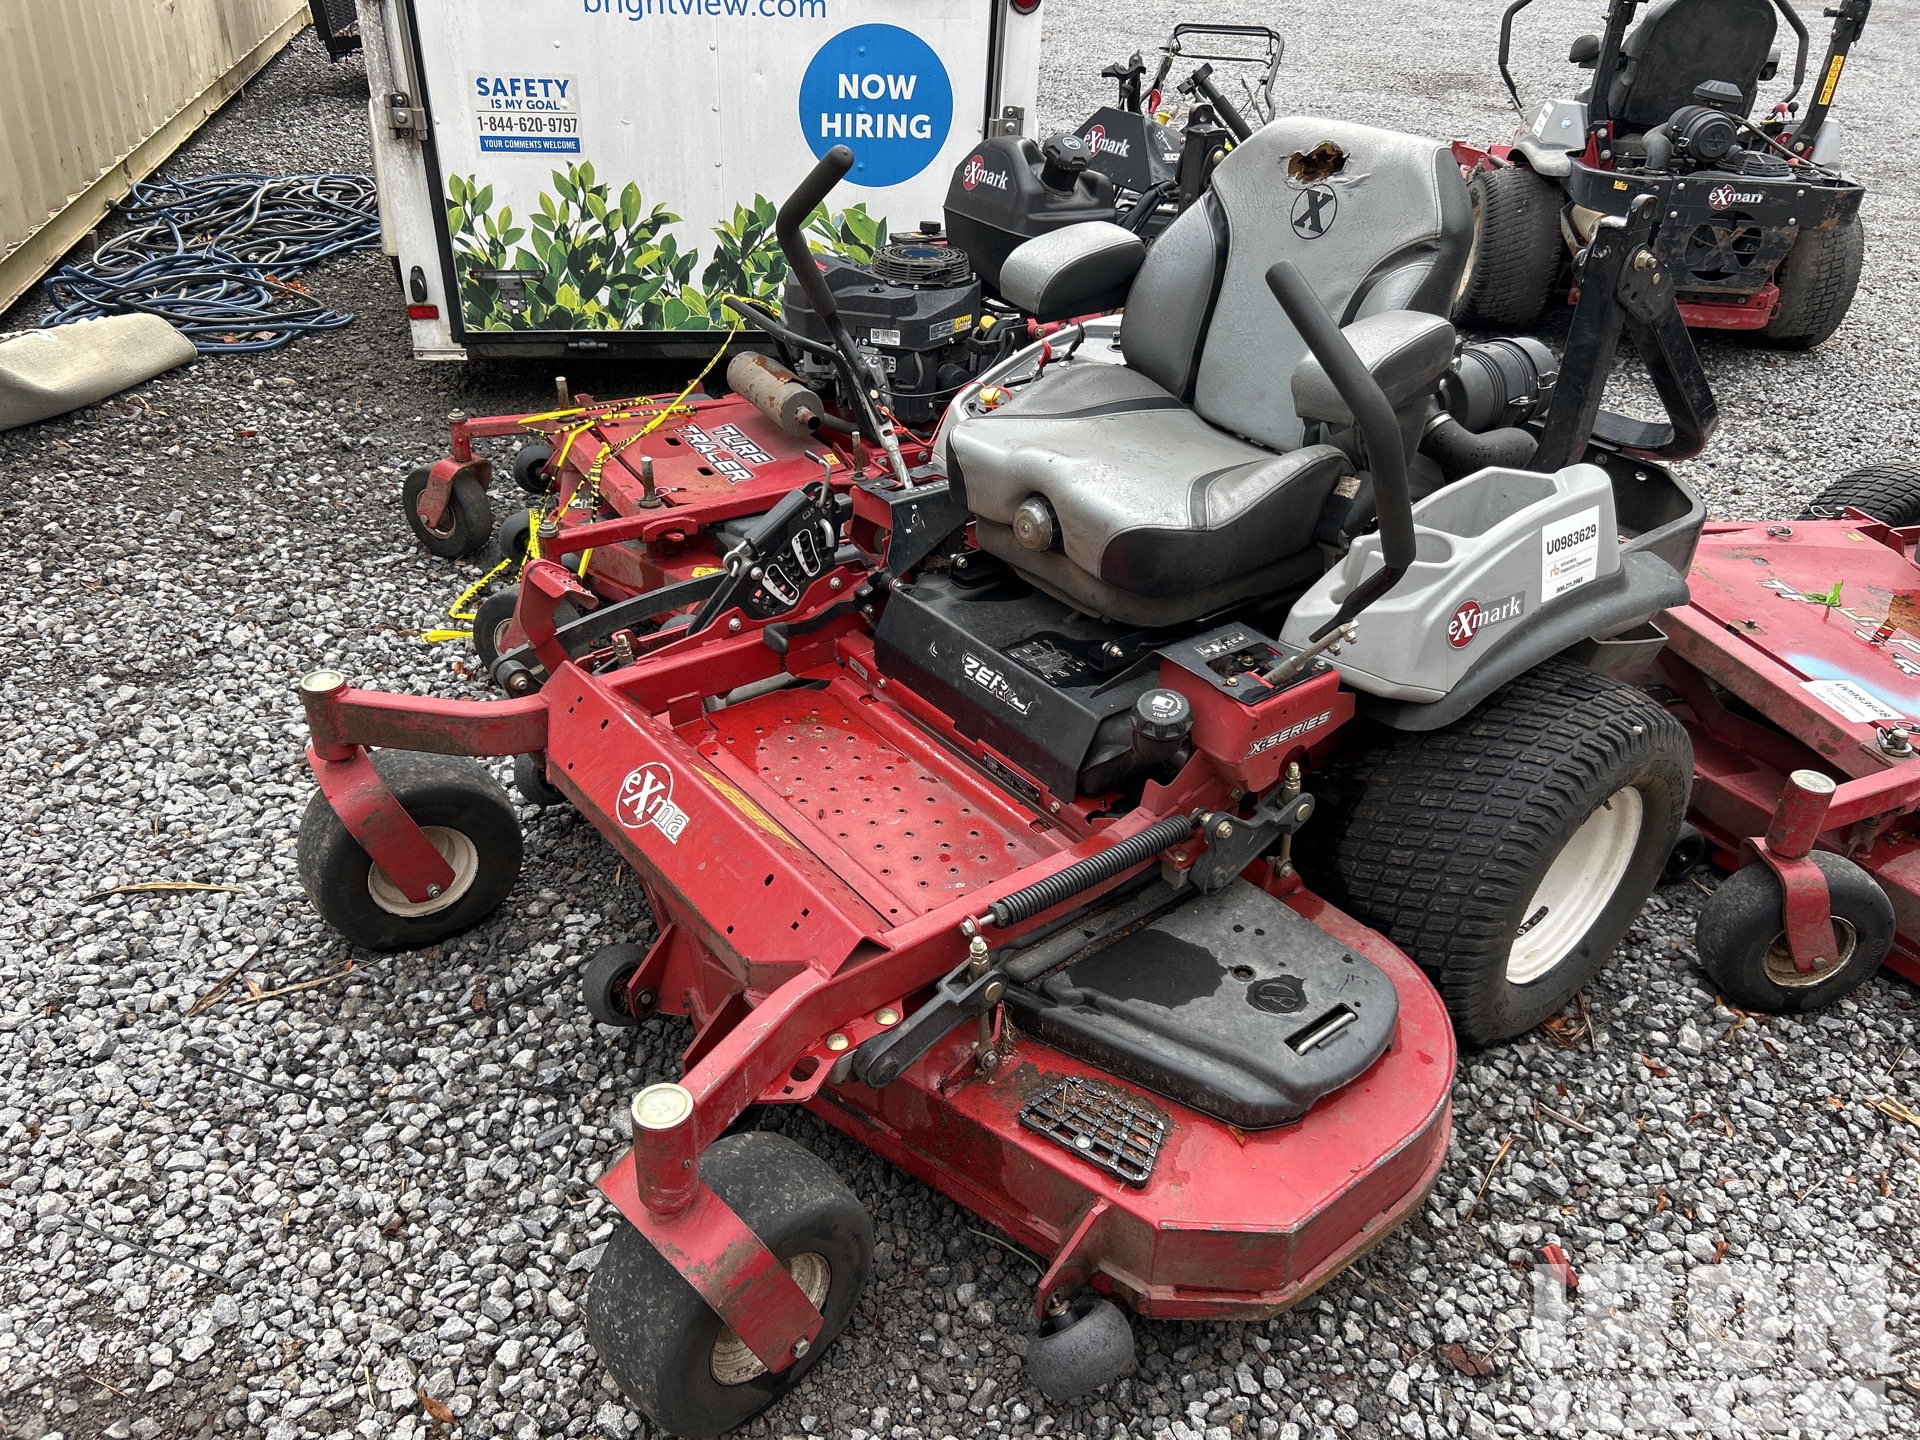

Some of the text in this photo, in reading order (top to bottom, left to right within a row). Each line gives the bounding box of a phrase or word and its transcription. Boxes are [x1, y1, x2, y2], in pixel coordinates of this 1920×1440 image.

[475, 77, 570, 98] SAFETY
[838, 73, 918, 100] NOW
[491, 98, 561, 110] IS MY GOAL
[476, 115, 578, 133] 1-844-620-9797
[821, 112, 932, 139] HIRING
[483, 139, 577, 150] YOUR COMMENTS WELCOME
[963, 161, 1008, 190] eXmark
[711, 423, 776, 464] TURF
[1546, 523, 1597, 556] U0983629
[1448, 596, 1522, 642] eXmark
[1245, 709, 1332, 758] X-SERIES
